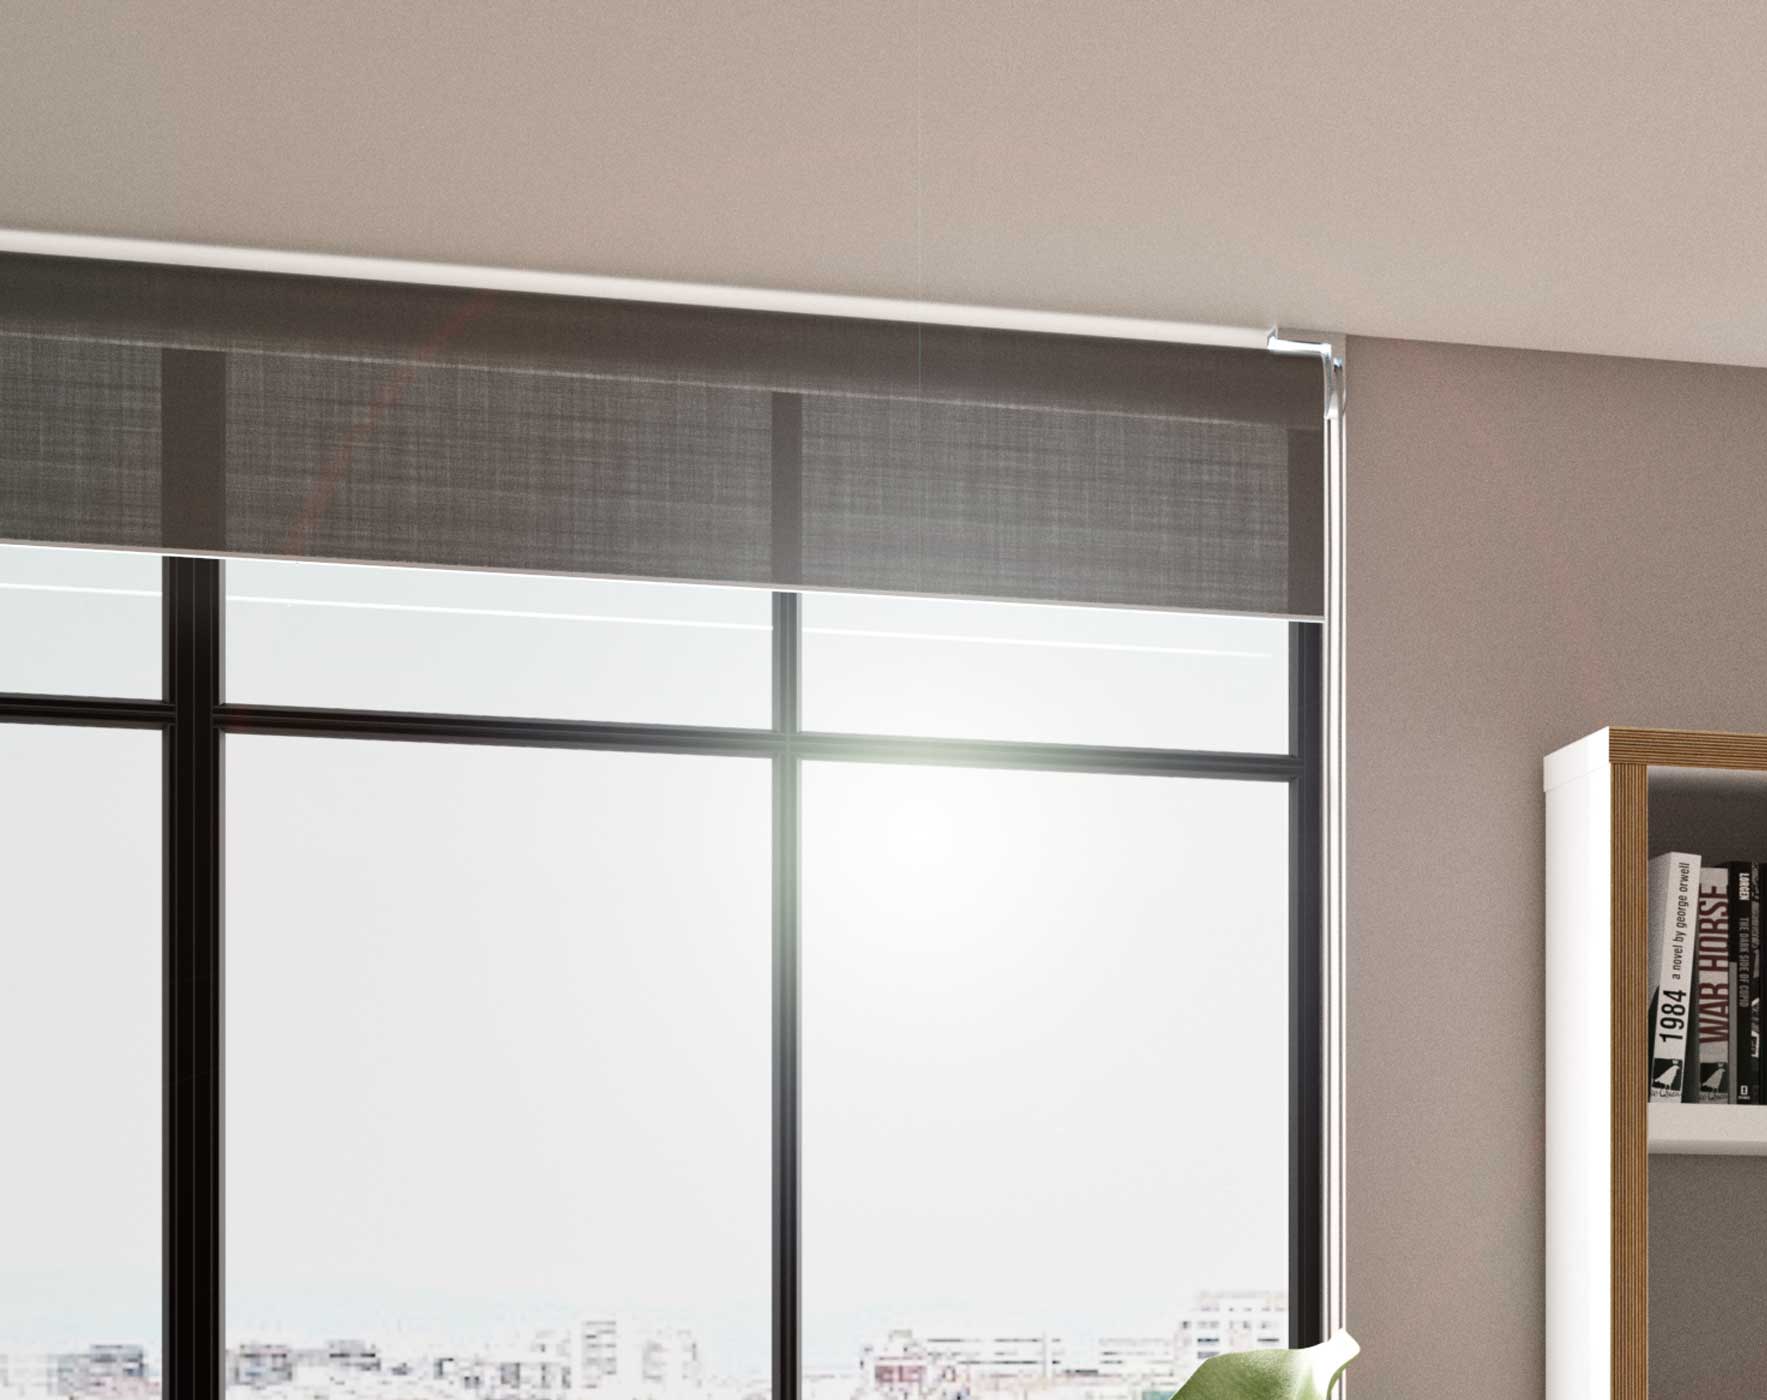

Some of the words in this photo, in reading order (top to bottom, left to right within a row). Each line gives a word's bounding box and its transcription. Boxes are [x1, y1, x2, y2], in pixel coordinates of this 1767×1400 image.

[1679, 863, 1690, 893] orwell
[1676, 894, 1689, 922] george
[1675, 922, 1686, 941] by
[1699, 885, 1729, 968] HORSE
[1672, 942, 1683, 972] novel
[1659, 989, 1686, 1043] 1984
[1699, 982, 1728, 1044] WAR
